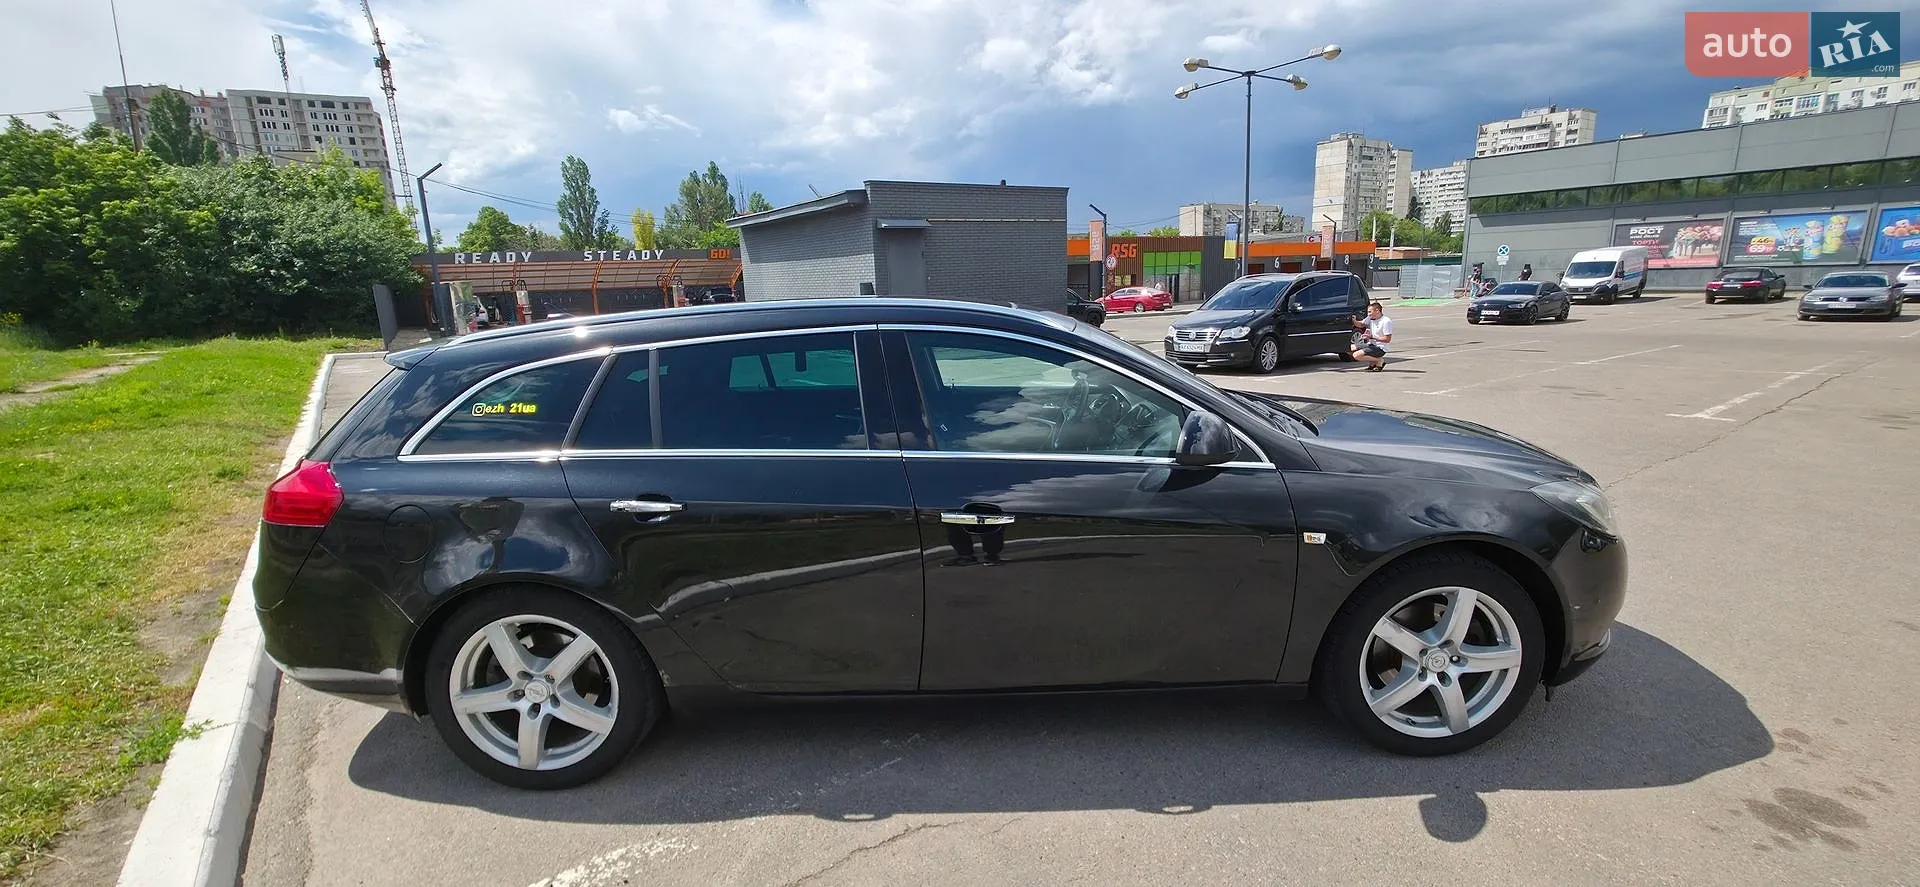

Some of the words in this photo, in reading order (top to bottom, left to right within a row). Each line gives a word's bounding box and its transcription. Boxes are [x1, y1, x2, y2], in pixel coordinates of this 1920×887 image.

[454, 251, 533, 264] READY
[583, 249, 665, 262] STEADY
[710, 249, 730, 259] GO!
[1111, 243, 1137, 258] RSG
[1274, 257, 1280, 268] 6
[1311, 255, 1316, 267] 7
[1344, 254, 1349, 265] 8
